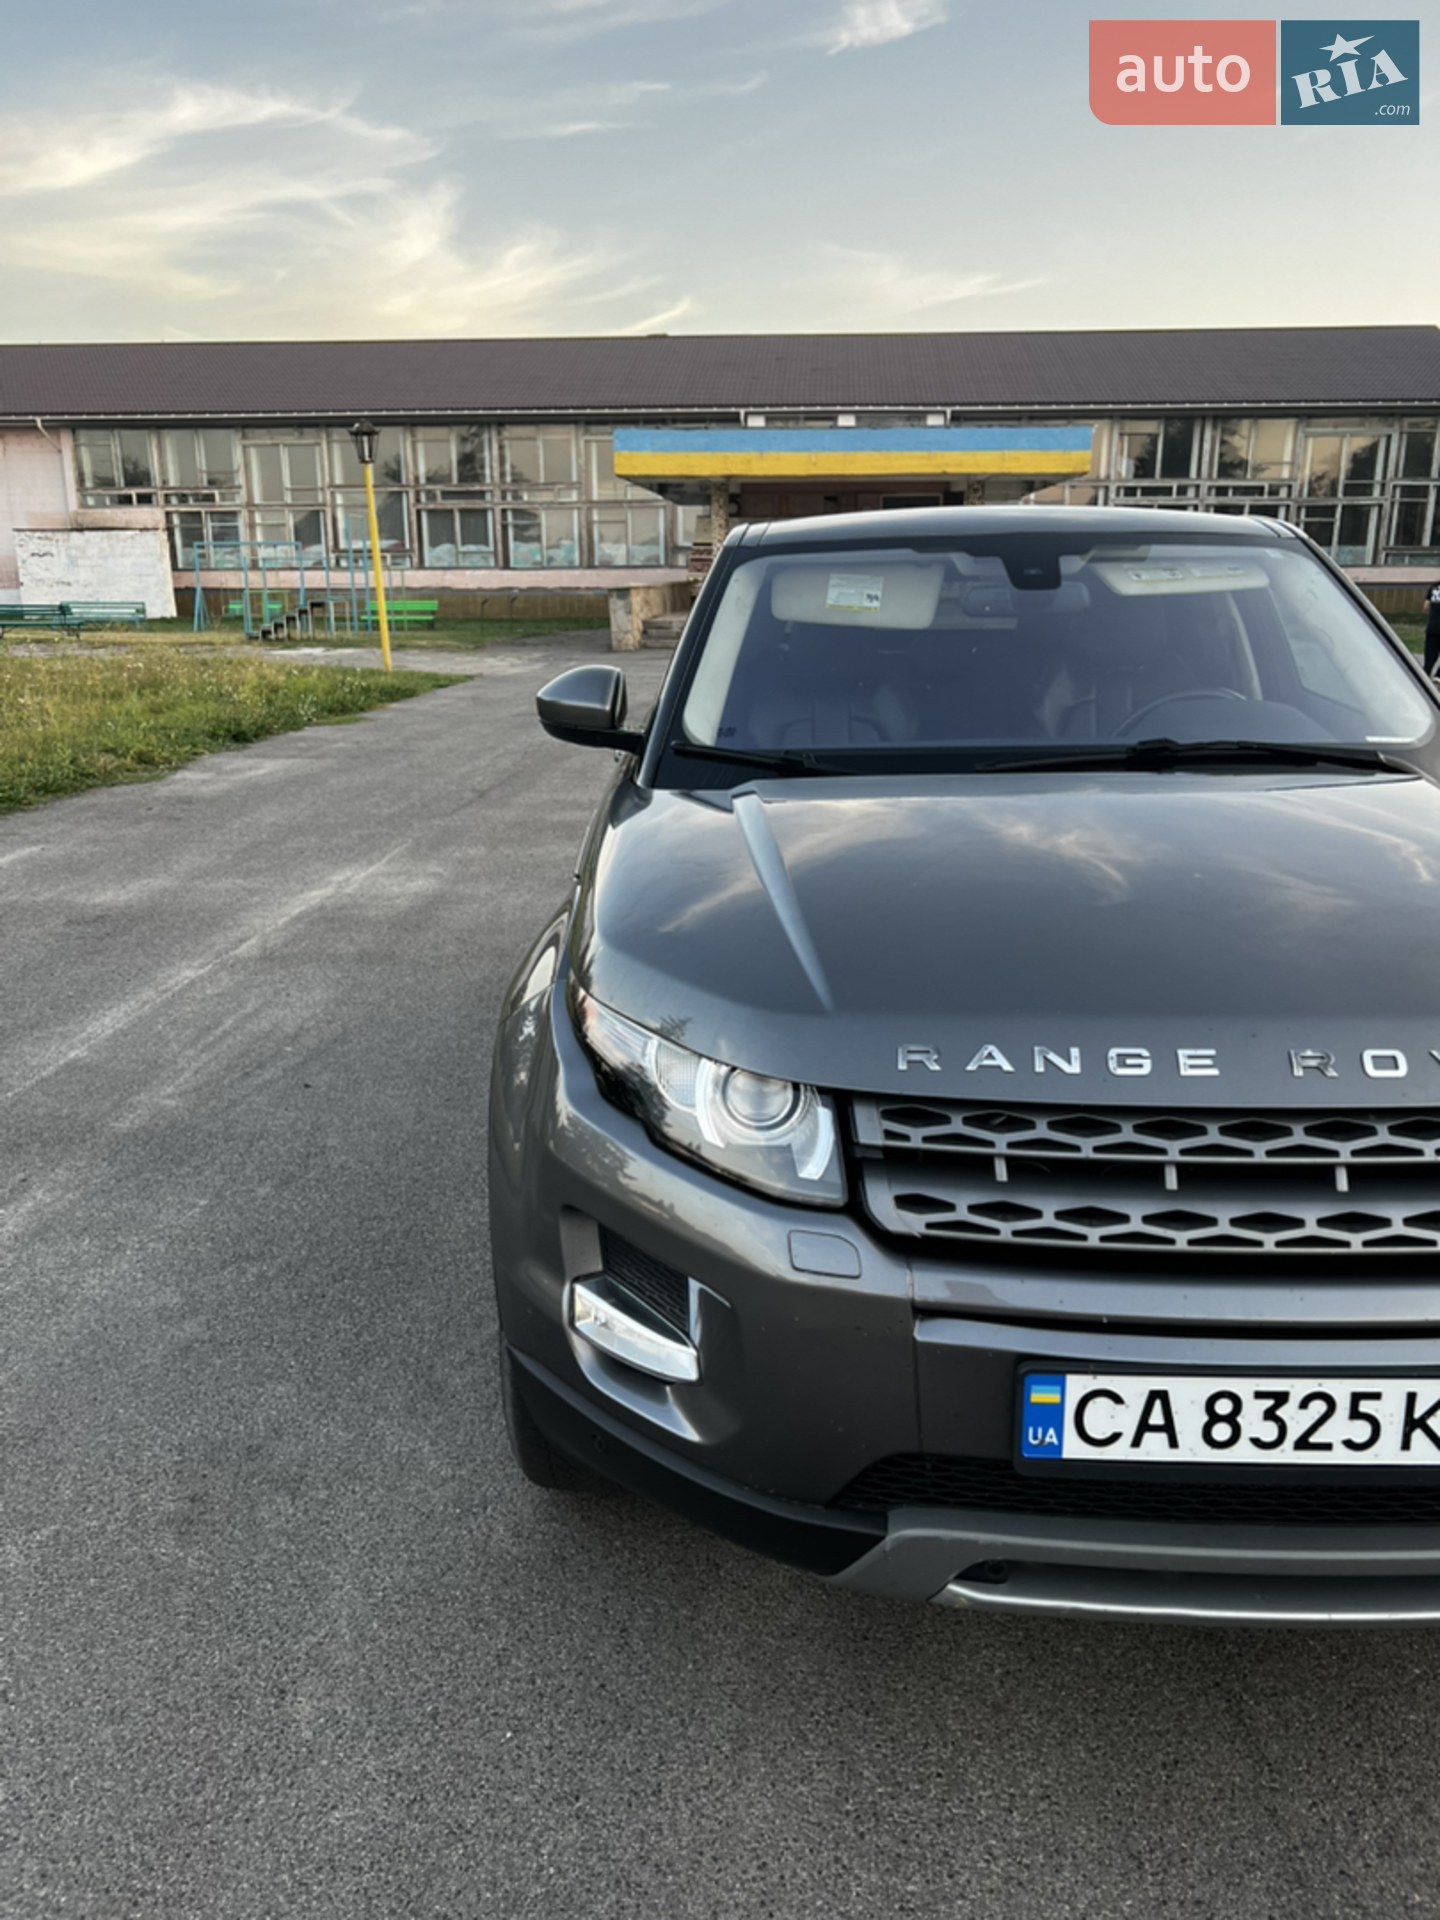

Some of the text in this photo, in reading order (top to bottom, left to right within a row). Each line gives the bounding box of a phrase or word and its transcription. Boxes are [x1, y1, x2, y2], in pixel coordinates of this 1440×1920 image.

[897, 1043, 1440, 1078] RANGE RO
[1028, 1426, 1059, 1446] UA
[1074, 1388, 1179, 1449] CA
[1201, 1390, 1383, 1452] 8325
